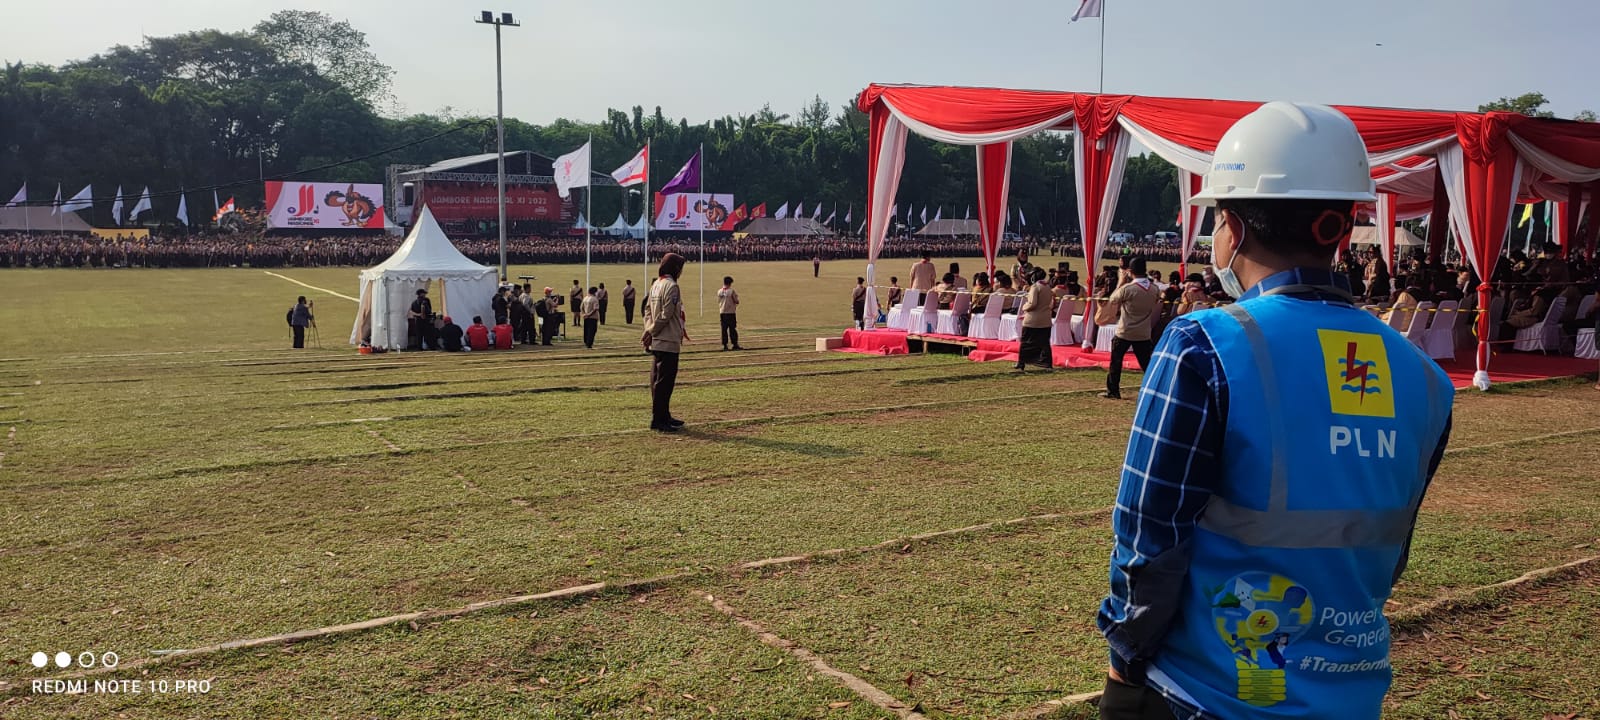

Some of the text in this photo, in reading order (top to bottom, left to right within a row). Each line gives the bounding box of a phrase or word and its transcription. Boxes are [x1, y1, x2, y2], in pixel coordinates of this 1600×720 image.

[431, 196, 470, 204] JAMBORE
[473, 196, 514, 204] NASIOAL
[528, 197, 547, 205] 2022
[1329, 425, 1397, 459] PLN
[1324, 626, 1388, 649] Genera
